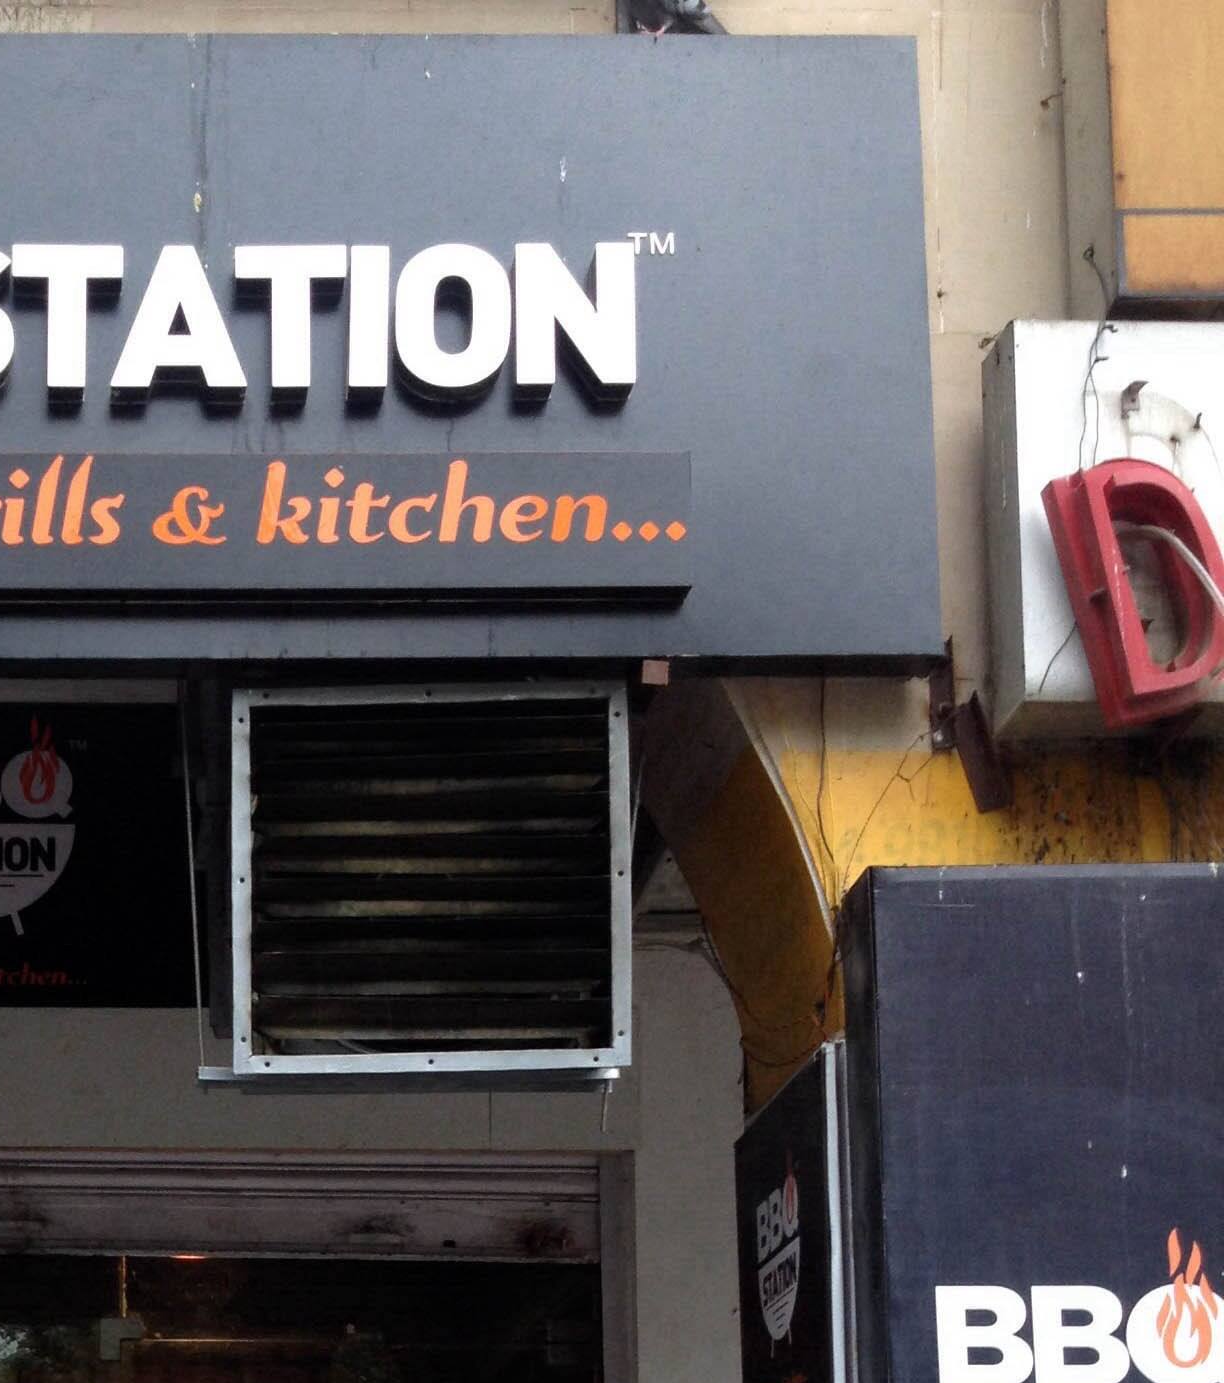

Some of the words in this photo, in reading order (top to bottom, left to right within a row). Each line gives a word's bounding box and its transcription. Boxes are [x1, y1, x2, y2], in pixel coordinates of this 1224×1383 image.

[628, 231, 676, 256] TM
[152, 485, 228, 546] &
[756, 1173, 799, 1265] BBQ
[762, 1251, 797, 1307] STATION
